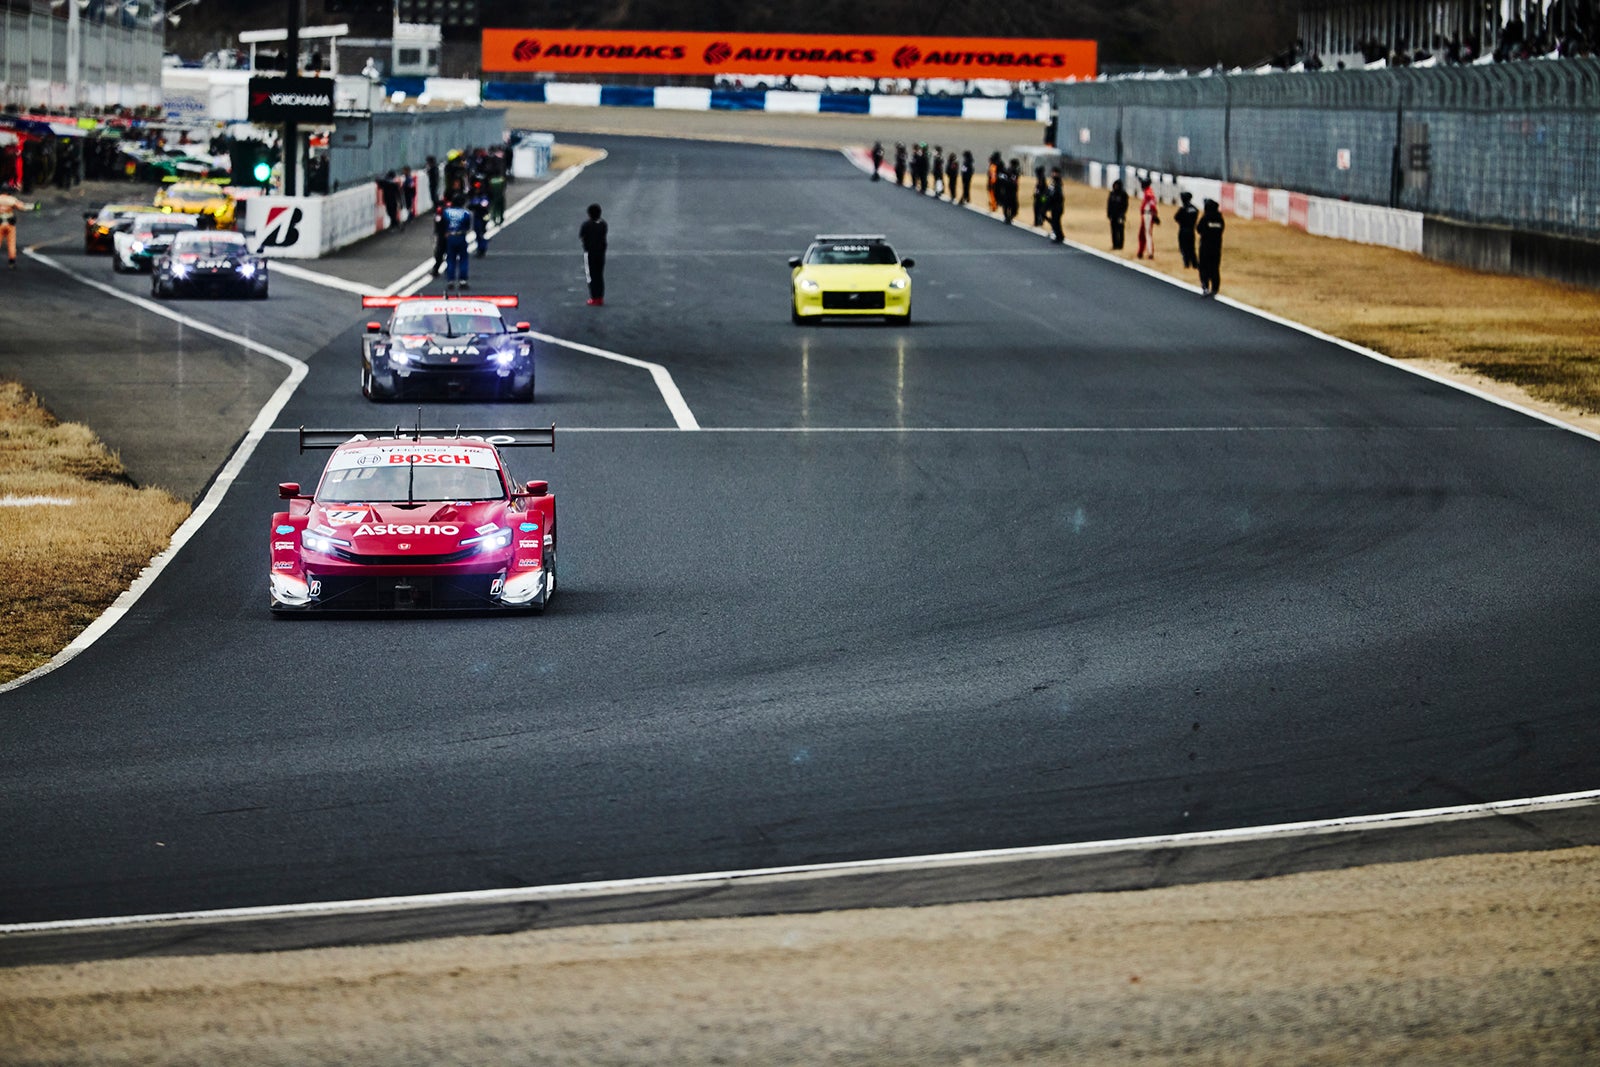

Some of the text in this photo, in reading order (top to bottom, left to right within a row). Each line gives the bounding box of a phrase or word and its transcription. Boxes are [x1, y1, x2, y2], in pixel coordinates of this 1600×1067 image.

[542, 44, 687, 60] AUTOBACS
[735, 48, 877, 63] AUTOBACS
[923, 51, 1066, 67] AUTOBACS
[268, 92, 330, 106] YOKOHAMA
[434, 306, 483, 314] BOSCH
[427, 346, 480, 355] ARTA
[389, 454, 471, 465] BOSCH
[331, 511, 359, 519] 17
[352, 523, 460, 537] Astemo
